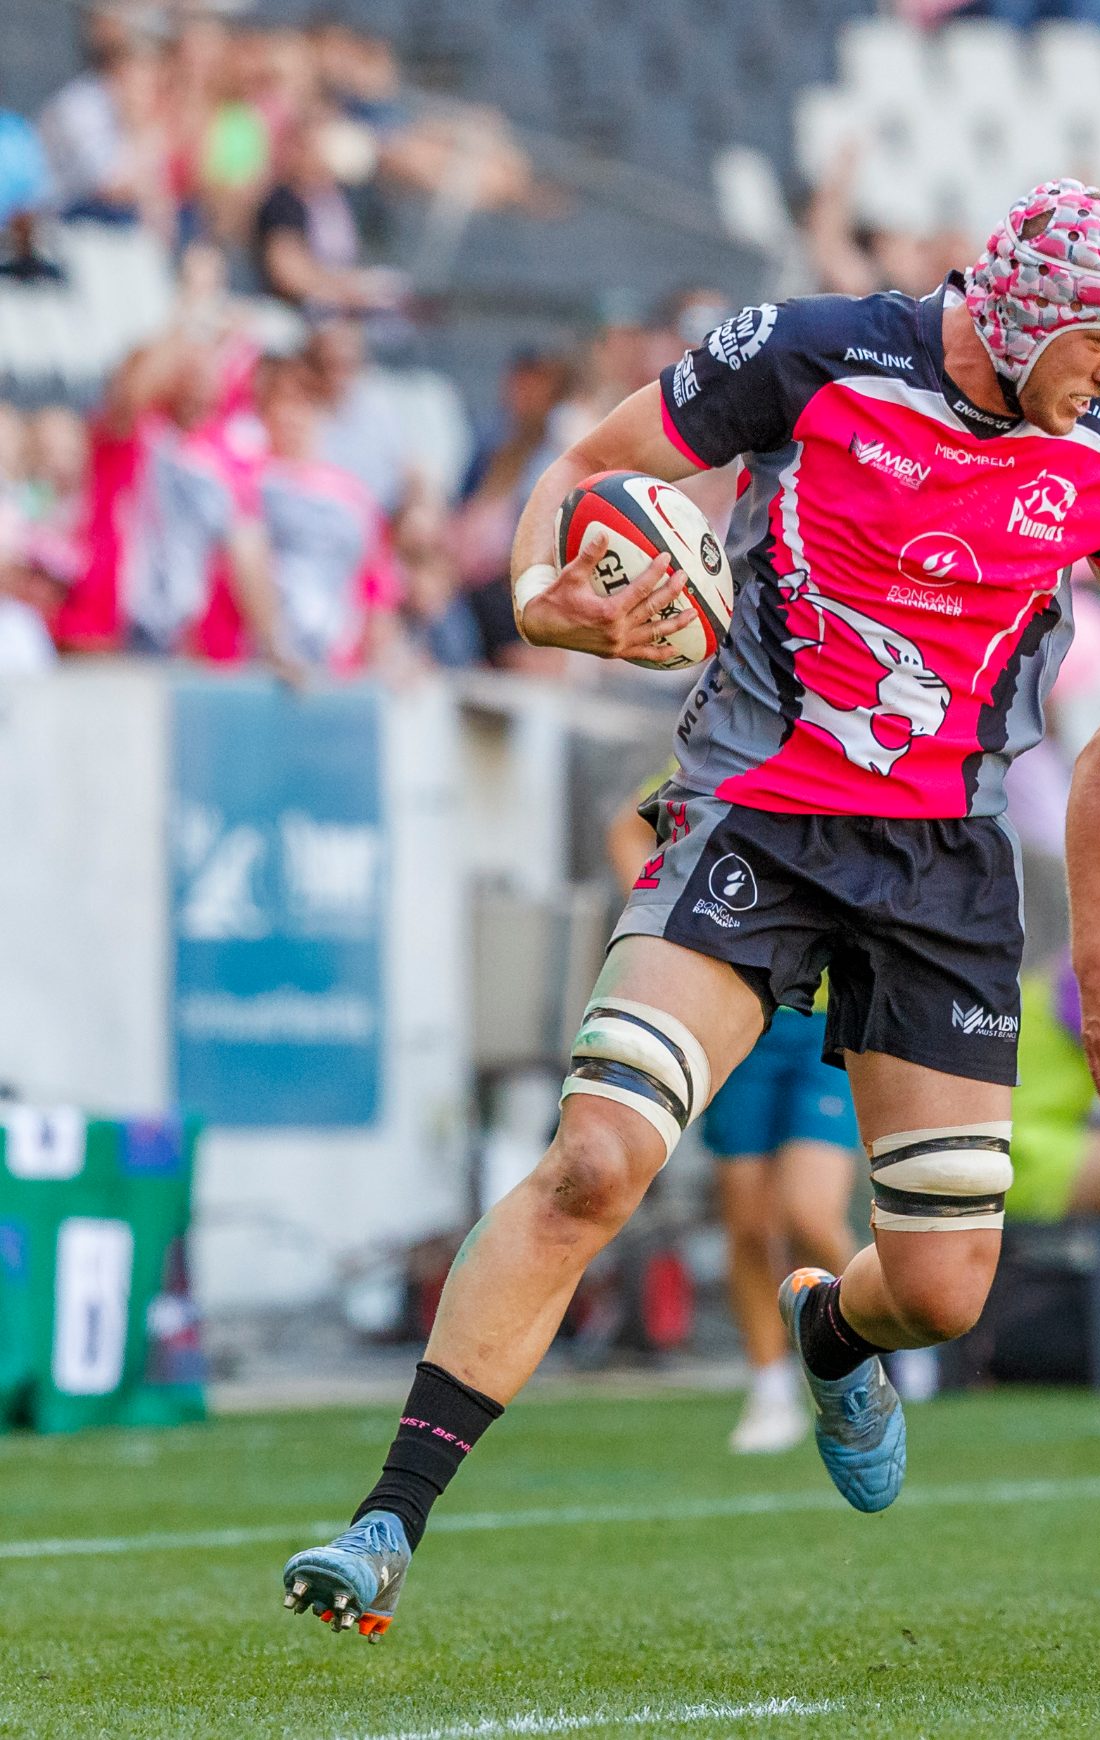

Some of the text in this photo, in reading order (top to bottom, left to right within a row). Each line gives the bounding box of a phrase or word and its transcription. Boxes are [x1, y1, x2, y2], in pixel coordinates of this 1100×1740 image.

[844, 347, 914, 370] AIRLINK
[877, 450, 931, 481] MBN
[1007, 496, 1064, 542] Pumas
[887, 585, 963, 608] BONGANI
[980, 1014, 1018, 1032] MBN
[400, 1417, 430, 1429] UST
[432, 1427, 457, 1441] BE
